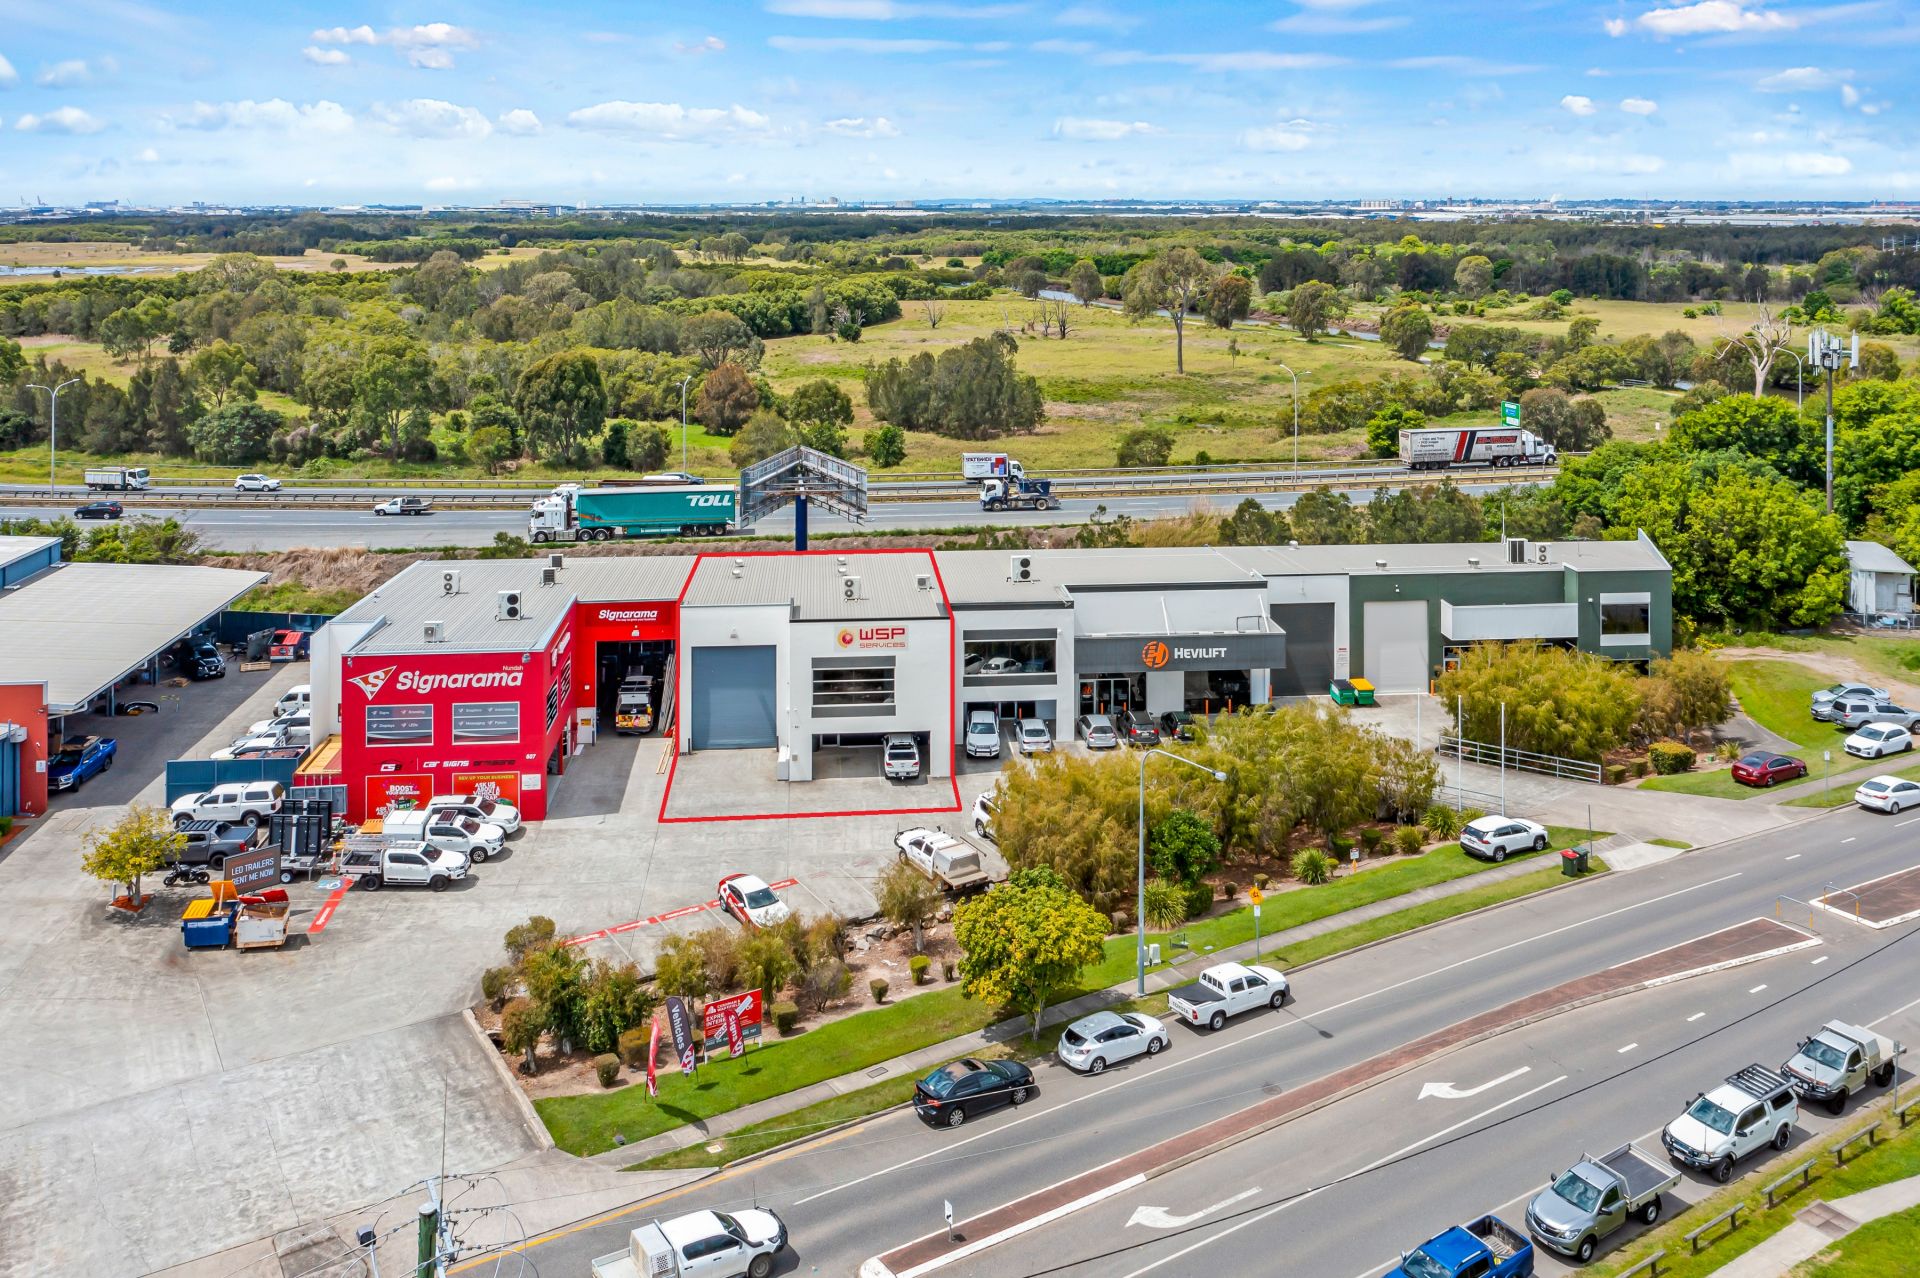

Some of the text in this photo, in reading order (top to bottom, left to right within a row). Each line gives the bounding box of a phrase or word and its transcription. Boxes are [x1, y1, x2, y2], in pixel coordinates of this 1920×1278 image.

[686, 494, 732, 507] TOLL
[598, 609, 658, 621] Signarama
[859, 627, 905, 640] WSP
[1174, 647, 1228, 659] HEVILIFT
[396, 670, 524, 694] Signarama
[390, 784, 414, 792] BOOST
[231, 857, 275, 876] LED TRAILERS
[248, 872, 259, 882] ME
[259, 866, 275, 879] NOW
[1172, 1001, 1189, 1014] TOYOTA
[671, 1004, 686, 1050] Vehicles
[728, 1014, 738, 1043] Signs
